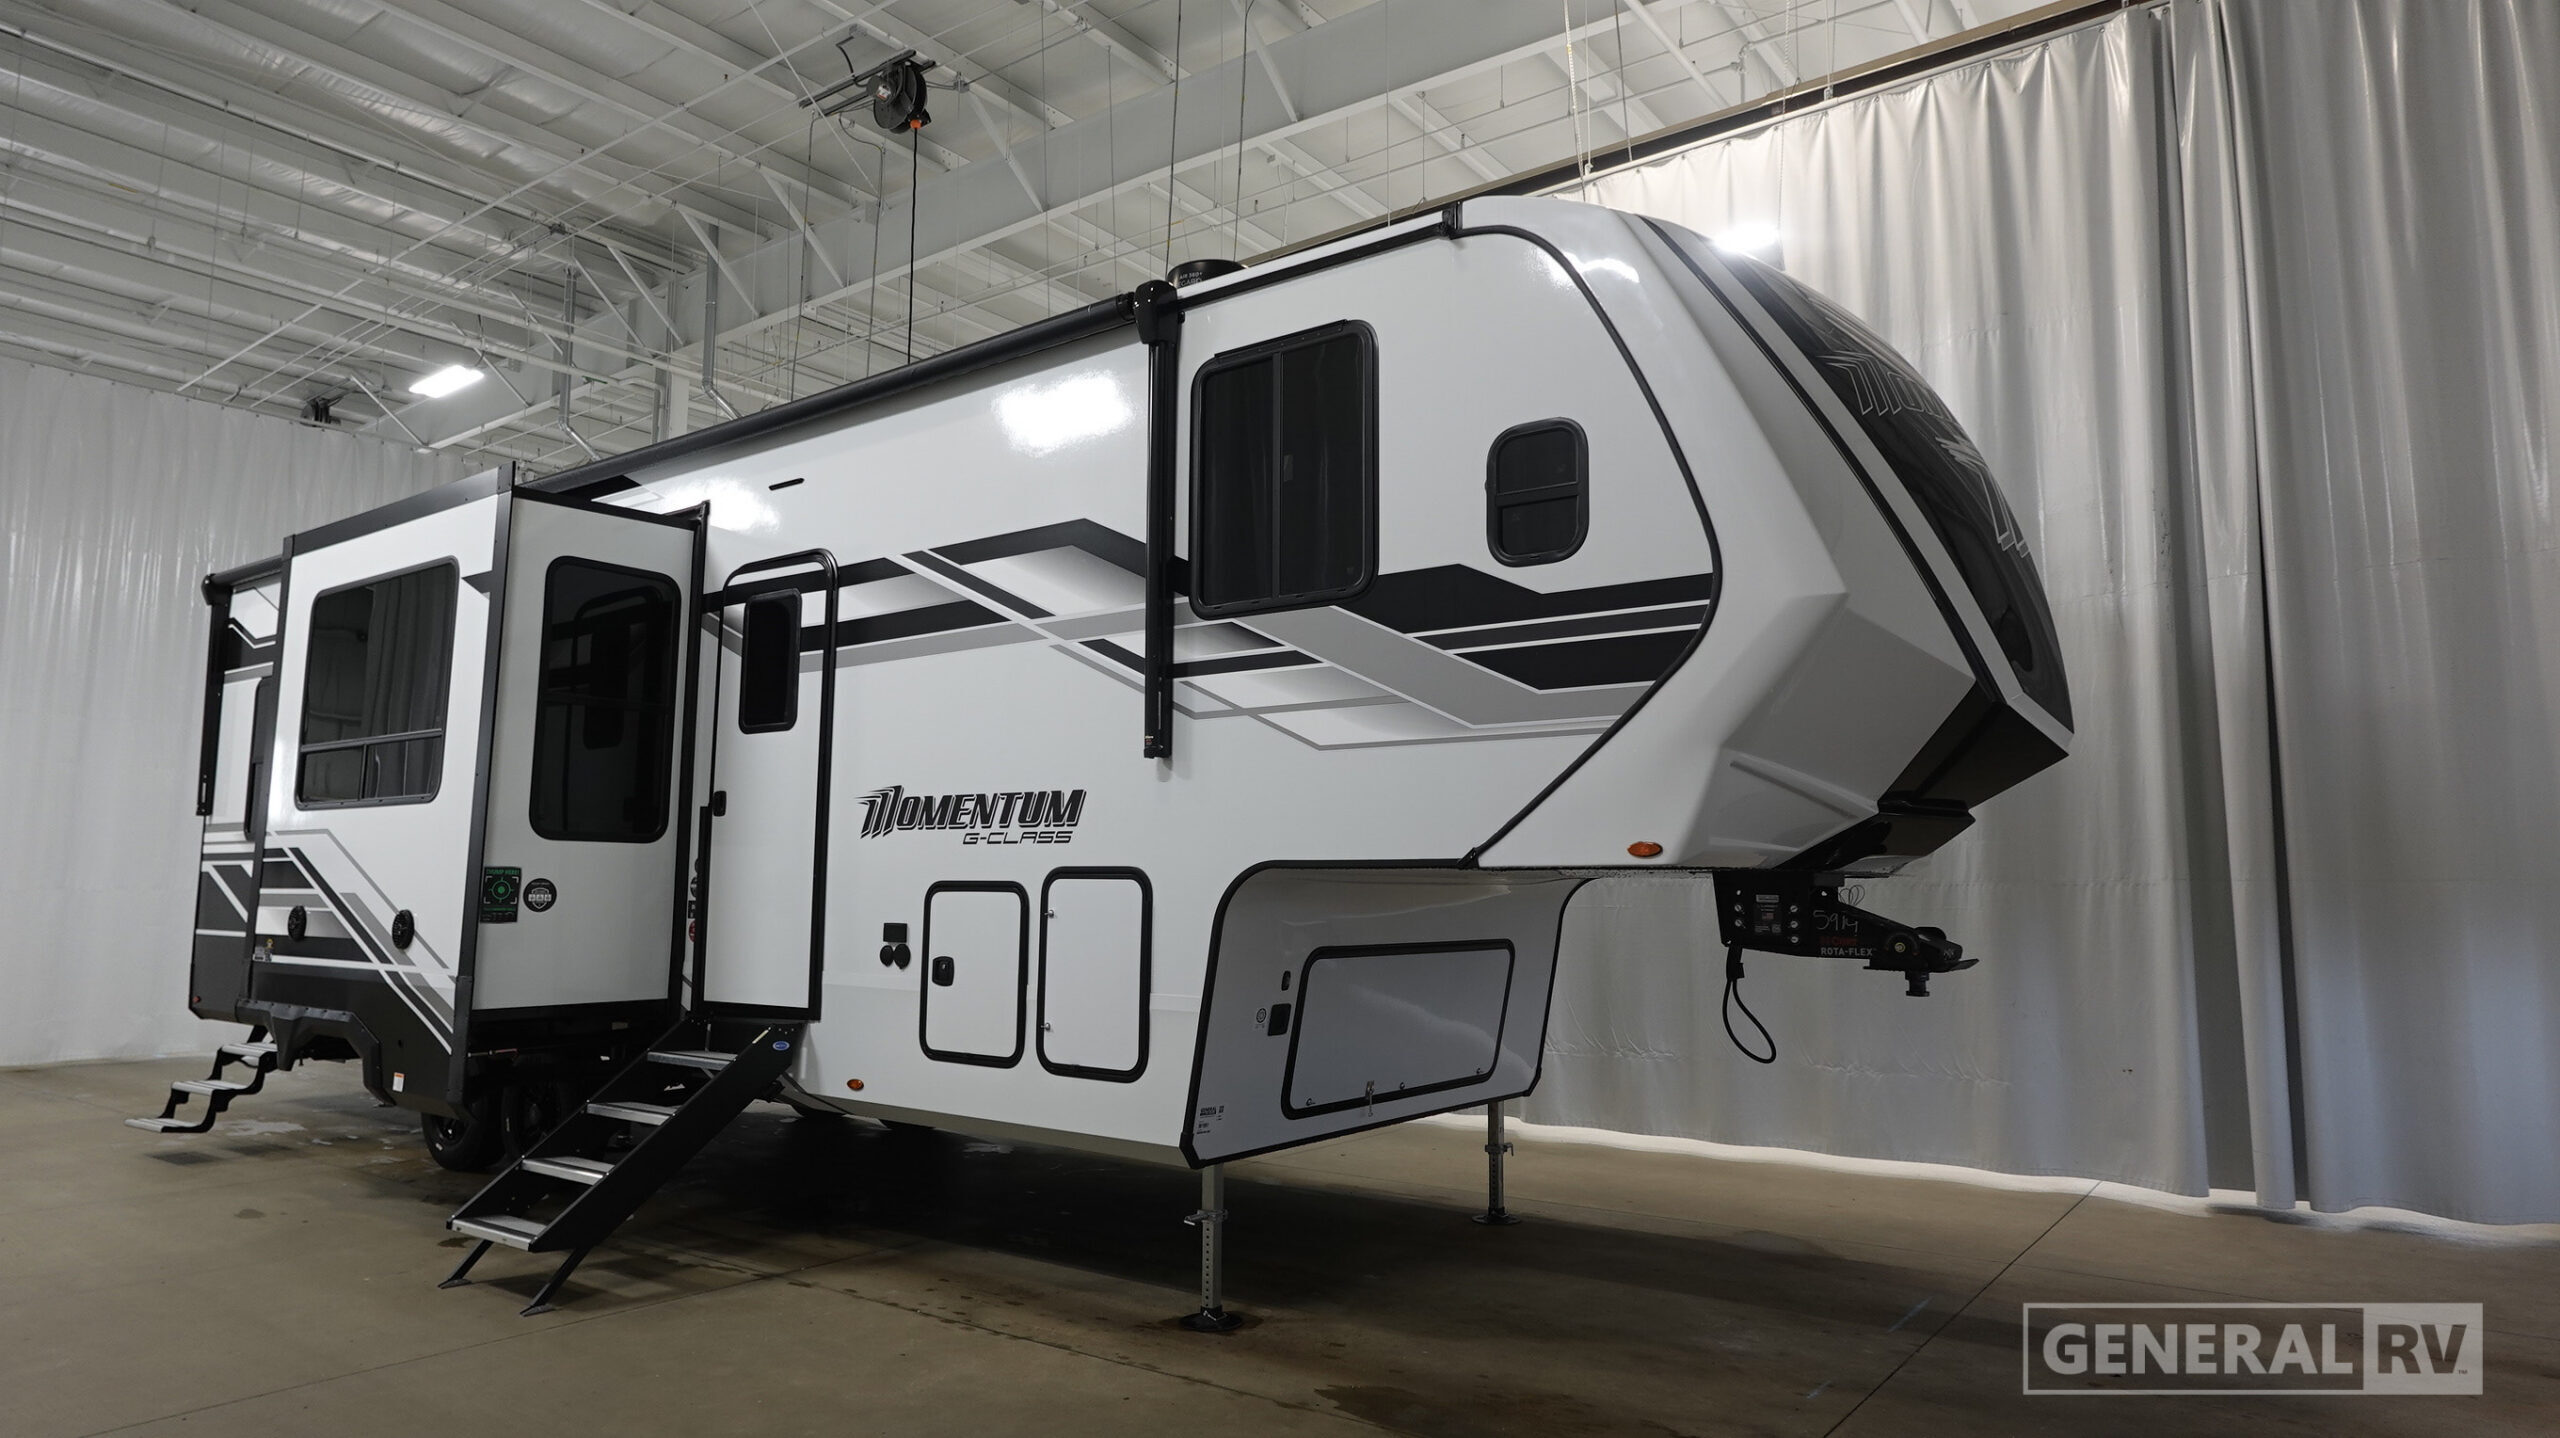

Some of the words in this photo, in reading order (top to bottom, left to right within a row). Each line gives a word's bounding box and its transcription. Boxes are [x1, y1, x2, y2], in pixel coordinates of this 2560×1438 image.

[854, 784, 1087, 839] MOMENTUM
[962, 830, 1074, 845] G-CLASS
[1820, 946, 1873, 957] ROTA-FLEX
